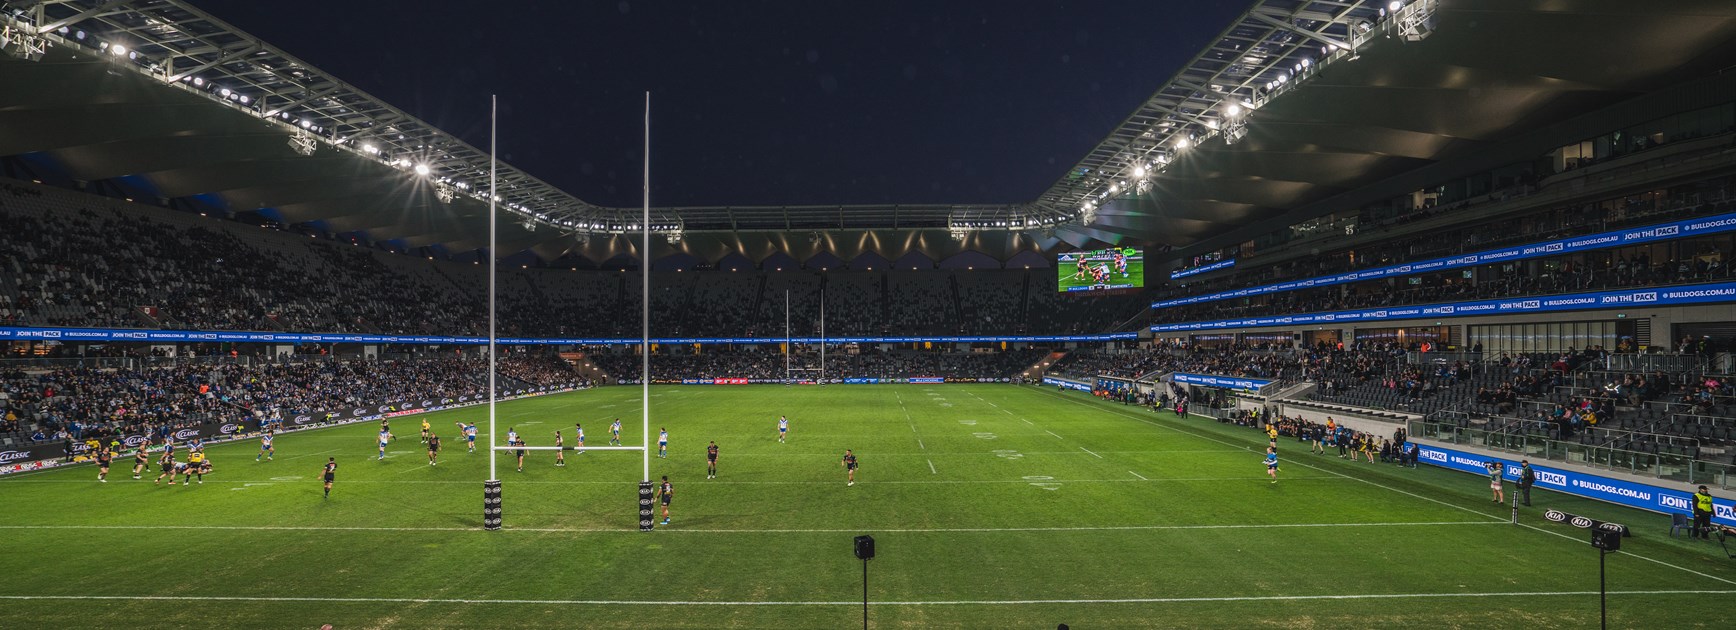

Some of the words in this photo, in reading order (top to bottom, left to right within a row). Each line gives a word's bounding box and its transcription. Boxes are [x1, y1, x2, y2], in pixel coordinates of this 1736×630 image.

[1658, 226, 1677, 235] PACK
[1572, 236, 1618, 247] BULLDOGS.COM.AU
[1484, 251, 1518, 259] BULLDOGS.COM.AU
[1669, 288, 1735, 298] BULLDOGS.COM.AU
[0, 451, 30, 461] CLASSIC
[1432, 452, 1445, 460] PACK
[1544, 473, 1564, 484] PACK
[1580, 481, 1650, 500] BULLDOGS.COM.AU
[1662, 496, 1687, 508] JOIN
